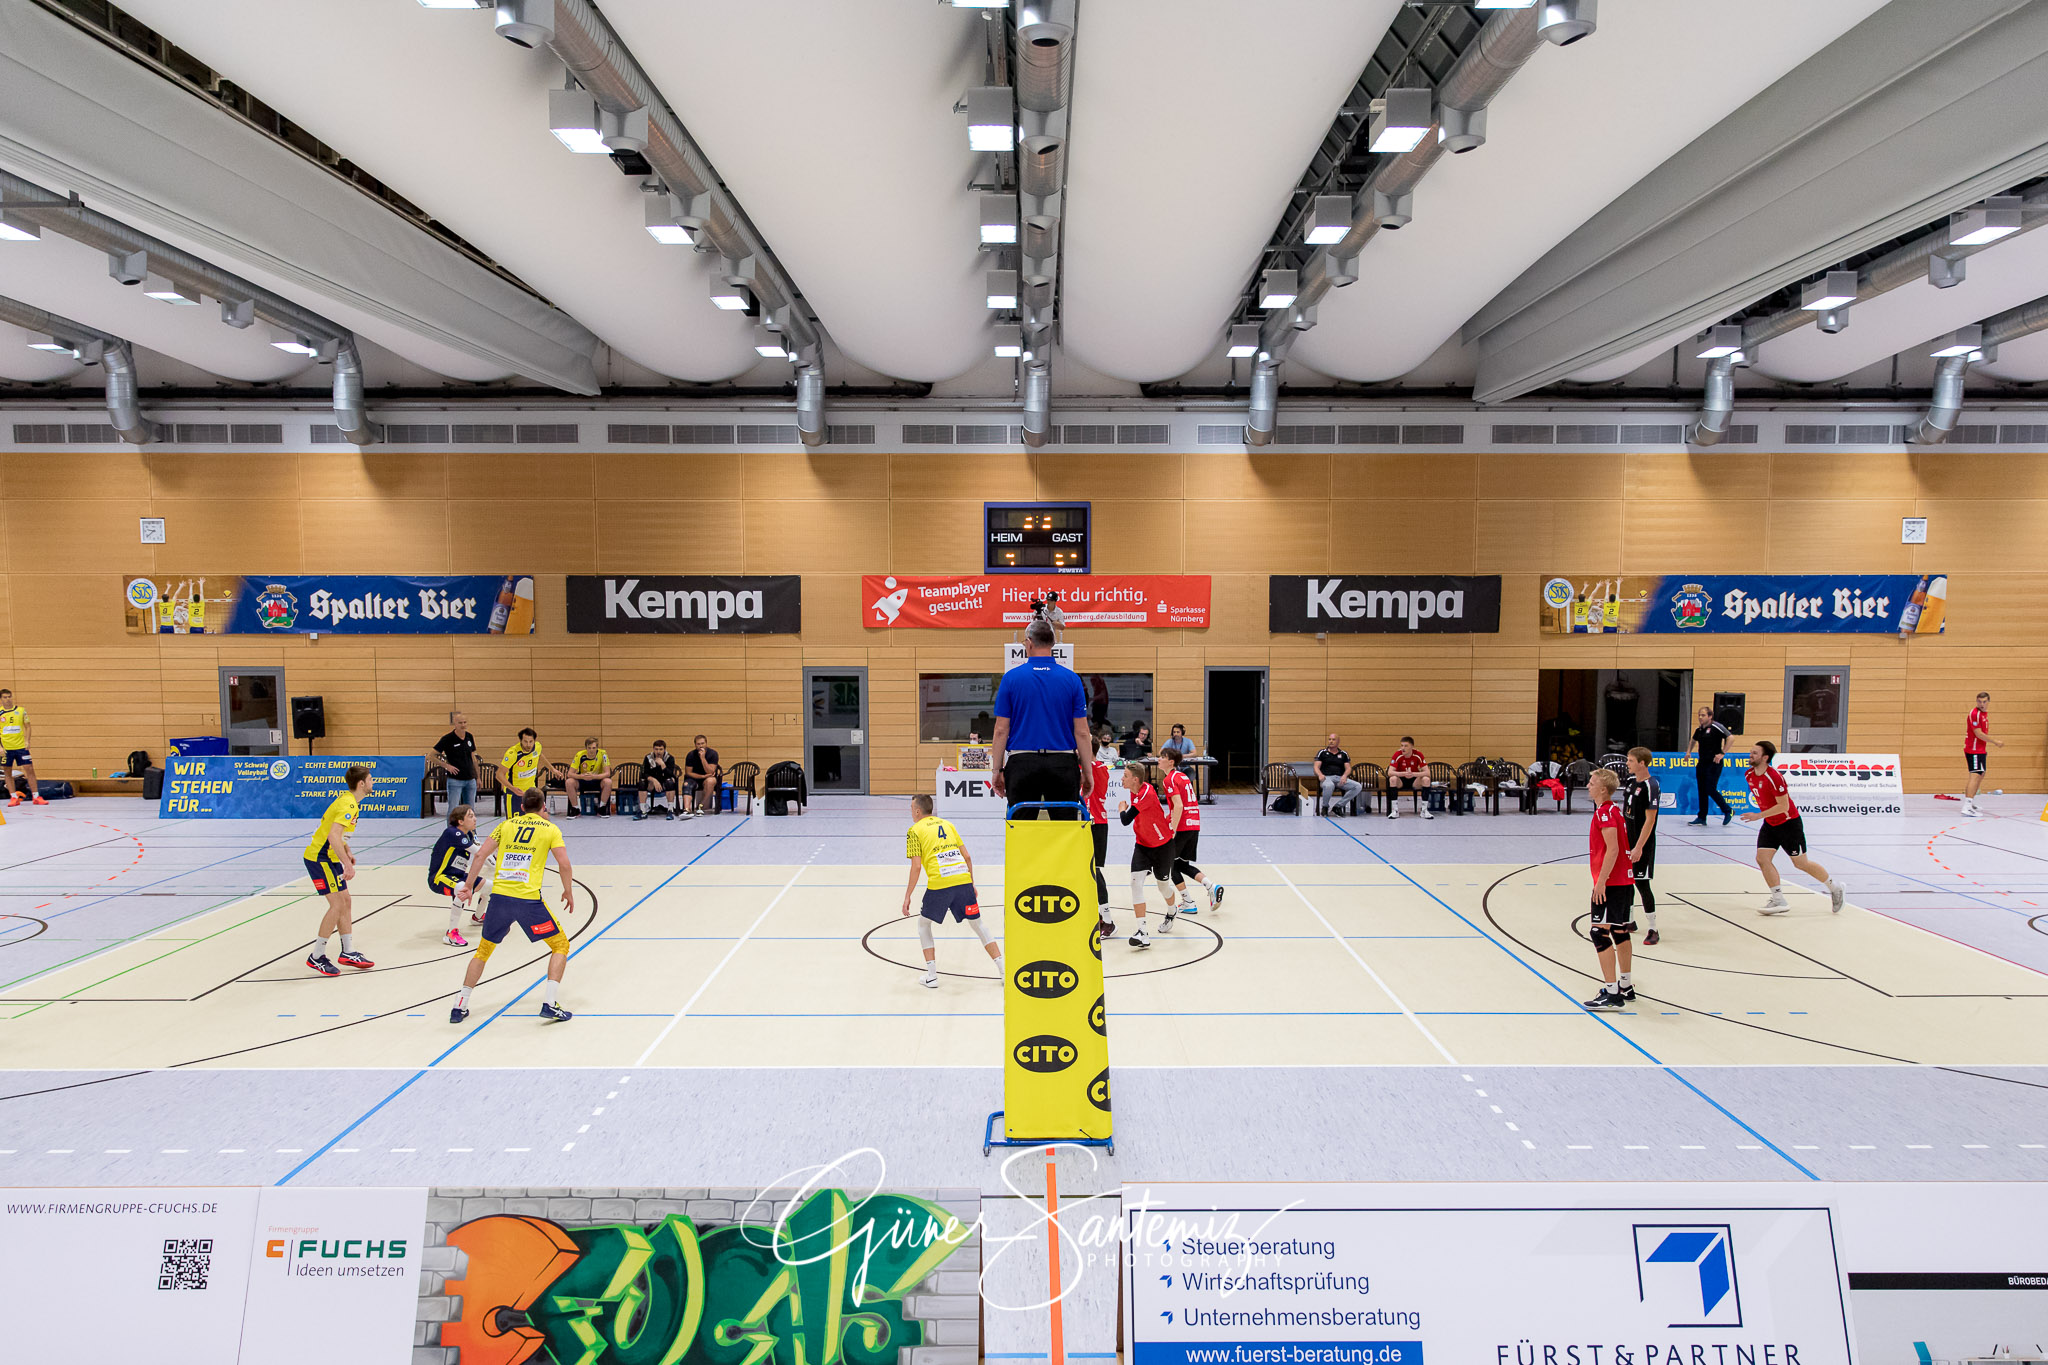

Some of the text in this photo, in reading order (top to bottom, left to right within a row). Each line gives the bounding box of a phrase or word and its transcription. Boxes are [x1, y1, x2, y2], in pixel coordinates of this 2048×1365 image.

[991, 533, 1083, 543] HEIM GAST
[917, 583, 990, 599] Teamplayer
[1002, 587, 1148, 605] Hier bst du richtig.
[309, 588, 477, 626] Spalter Bier
[604, 579, 763, 630] Kempa
[928, 597, 983, 616] gesucht!
[1170, 606, 1206, 615] Sparkasse
[1306, 579, 1464, 630] Kempa
[1721, 588, 1890, 626] Spalter Bier
[1170, 615, 1204, 624] Nürnberg
[173, 762, 206, 776] WIR
[237, 769, 268, 777] Volleyball
[244, 762, 269, 770] Schwaig
[1776, 759, 1895, 781] schweiger
[170, 780, 233, 794] STEHEN
[1797, 802, 1901, 816] w.schweiger.de
[513, 827, 536, 844] 10
[938, 825, 947, 840] 4
[1017, 895, 1077, 914] CITO
[1016, 971, 1076, 989] CITO
[1016, 1045, 1075, 1063] CITO
[7, 1202, 218, 1214] WWW.FIRMENGRUPPE-CFUCHS.DE
[267, 1225, 319, 1235] Firmengruppe
[298, 1240, 408, 1259] FUCHS
[1182, 1237, 1335, 1260] Steuerberatung
[296, 1264, 405, 1277] Ideen umsetzen
[1182, 1272, 1369, 1295] Wirtschaftsprüfung
[2007, 1275, 2048, 1286] BÜROBED
[1183, 1308, 1421, 1330] Unternehmensberatung
[1186, 1344, 1402, 1365] www.fuerst-beratung.de
